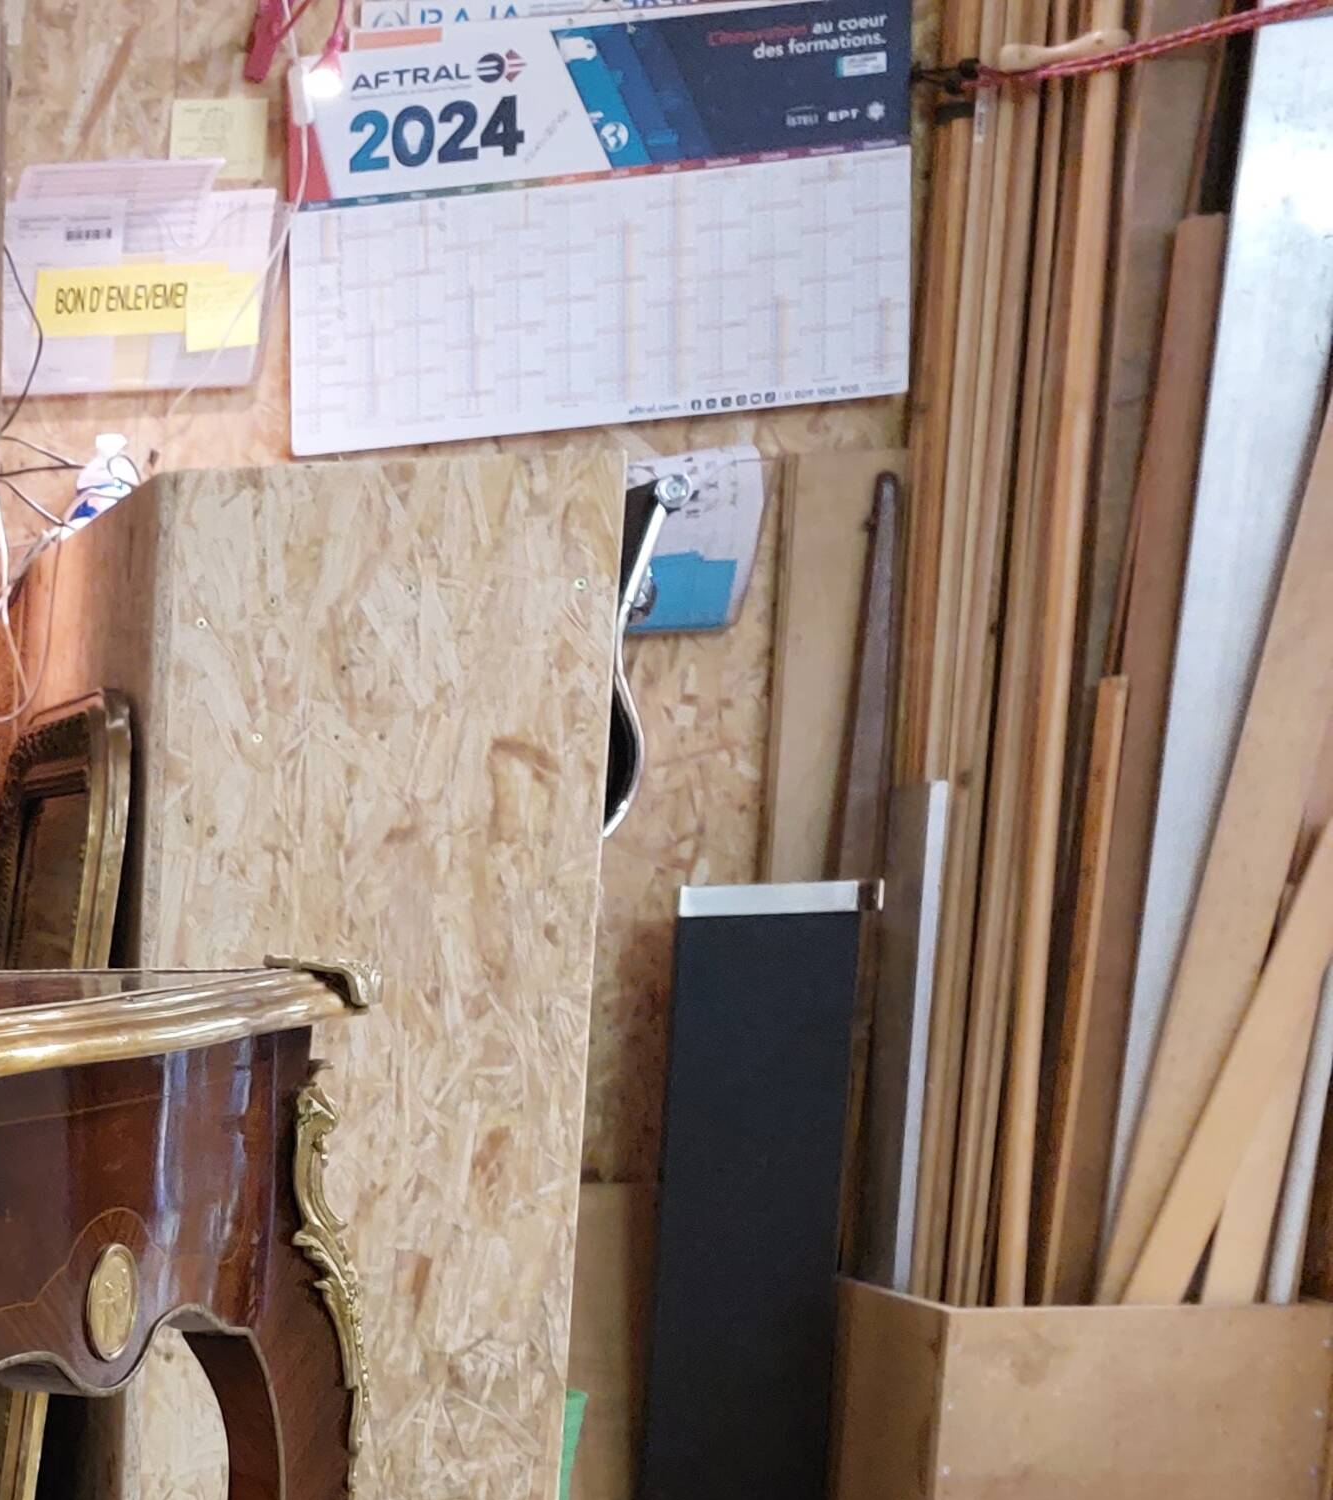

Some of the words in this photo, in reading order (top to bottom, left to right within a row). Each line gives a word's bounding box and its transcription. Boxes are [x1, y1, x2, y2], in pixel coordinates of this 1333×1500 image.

[812, 20, 833, 35] au
[838, 14, 888, 31] coeur
[753, 41, 784, 60] des
[788, 32, 887, 55] formations.
[351, 63, 471, 92] AFTRAL
[349, 95, 525, 174] 2024
[54, 287, 84, 315] BON
